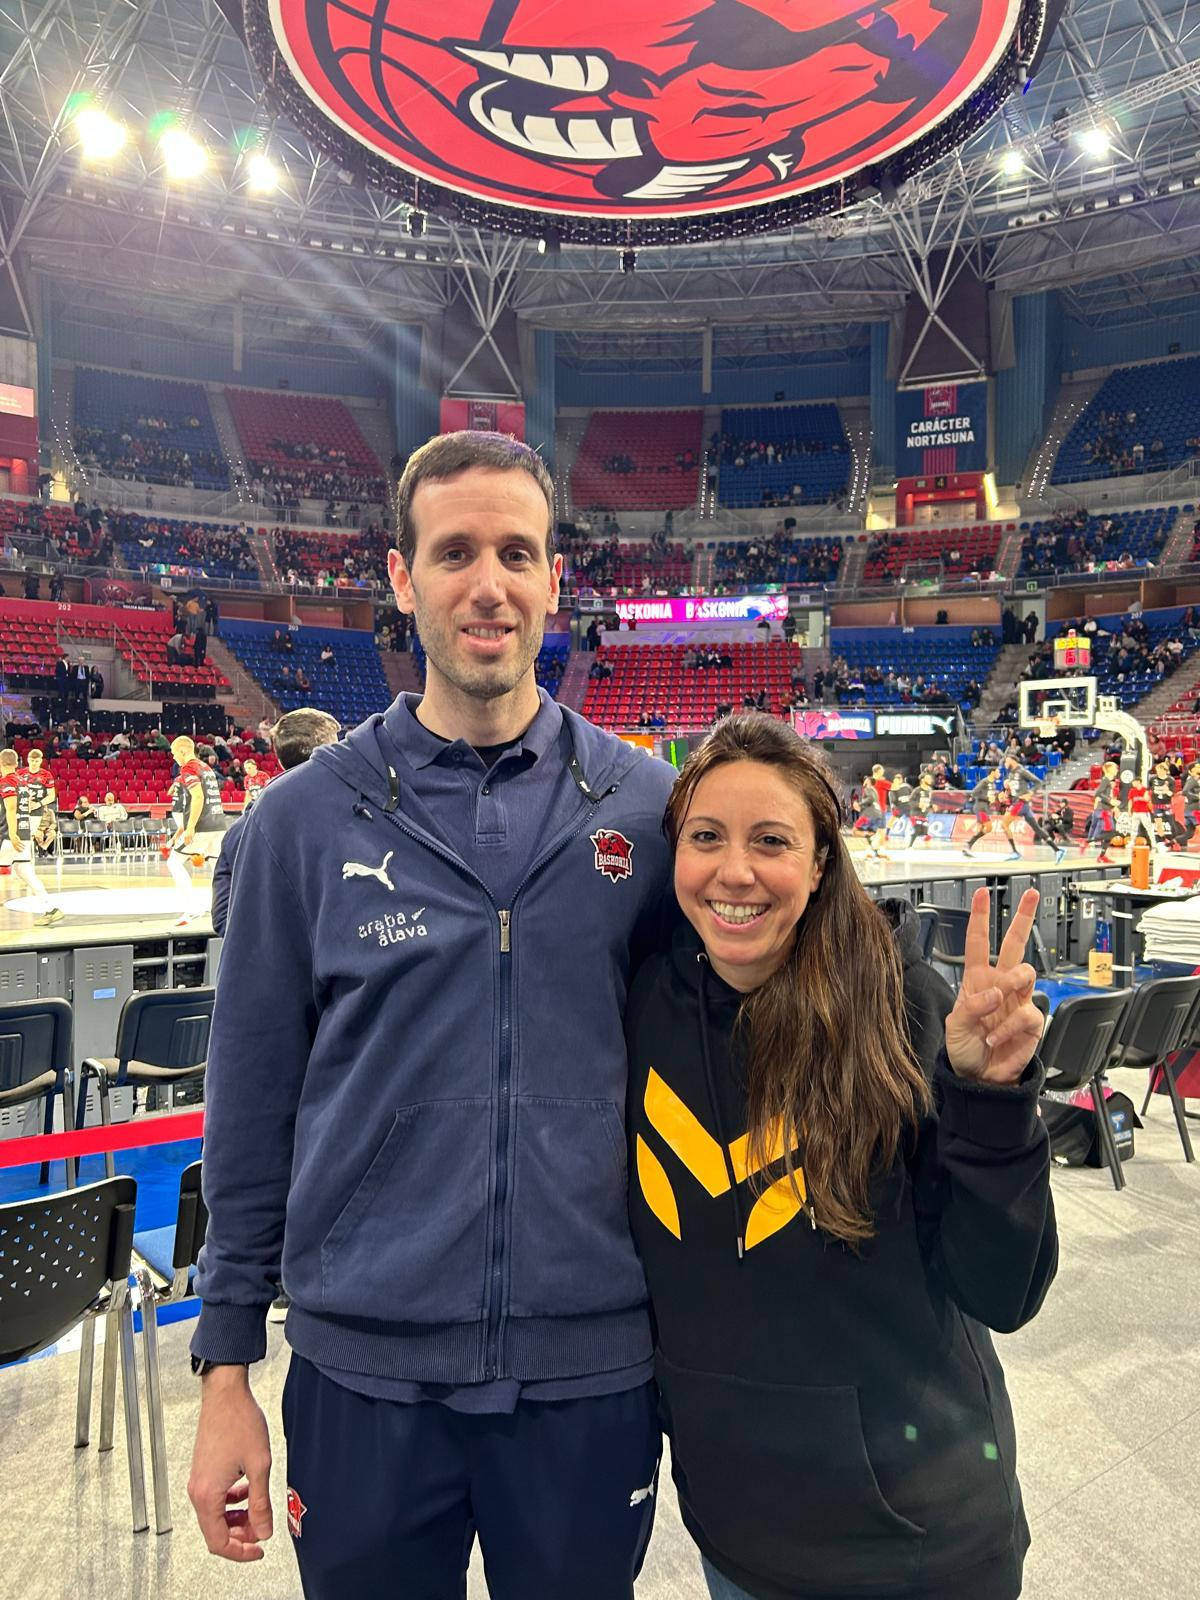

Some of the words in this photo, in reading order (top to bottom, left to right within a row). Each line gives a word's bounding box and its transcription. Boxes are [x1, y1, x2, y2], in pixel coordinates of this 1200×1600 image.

[910, 416, 971, 433] CARÁCTER
[906, 430, 975, 448] NORTASUNA
[685, 601, 748, 618] BASKONIA
[877, 715, 935, 735] PUMA
[358, 912, 407, 939] araba
[378, 924, 428, 947] álava
